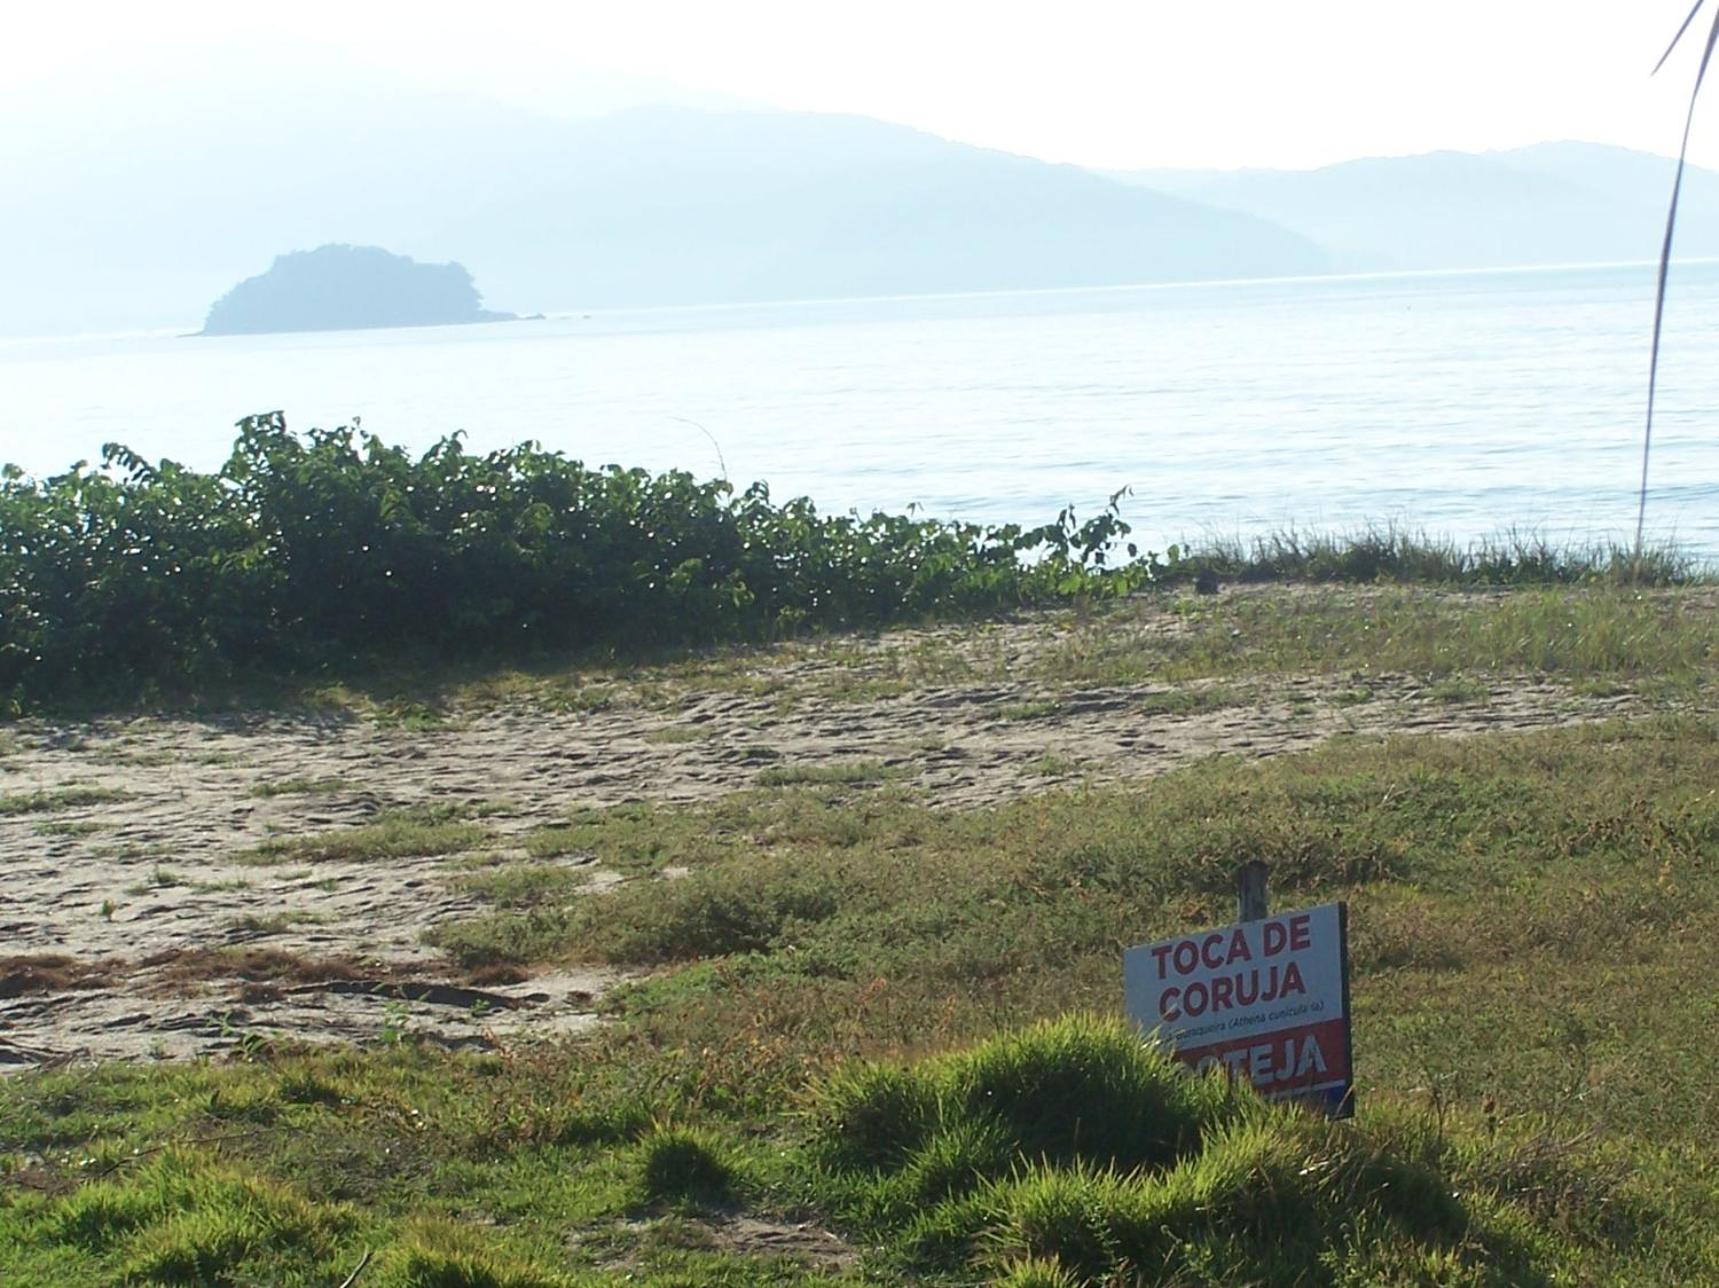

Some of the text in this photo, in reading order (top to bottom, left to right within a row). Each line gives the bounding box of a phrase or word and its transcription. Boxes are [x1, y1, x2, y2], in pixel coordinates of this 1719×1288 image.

[1151, 915, 1311, 980] TOCA DE
[1159, 962, 1307, 1022] CORUJA
